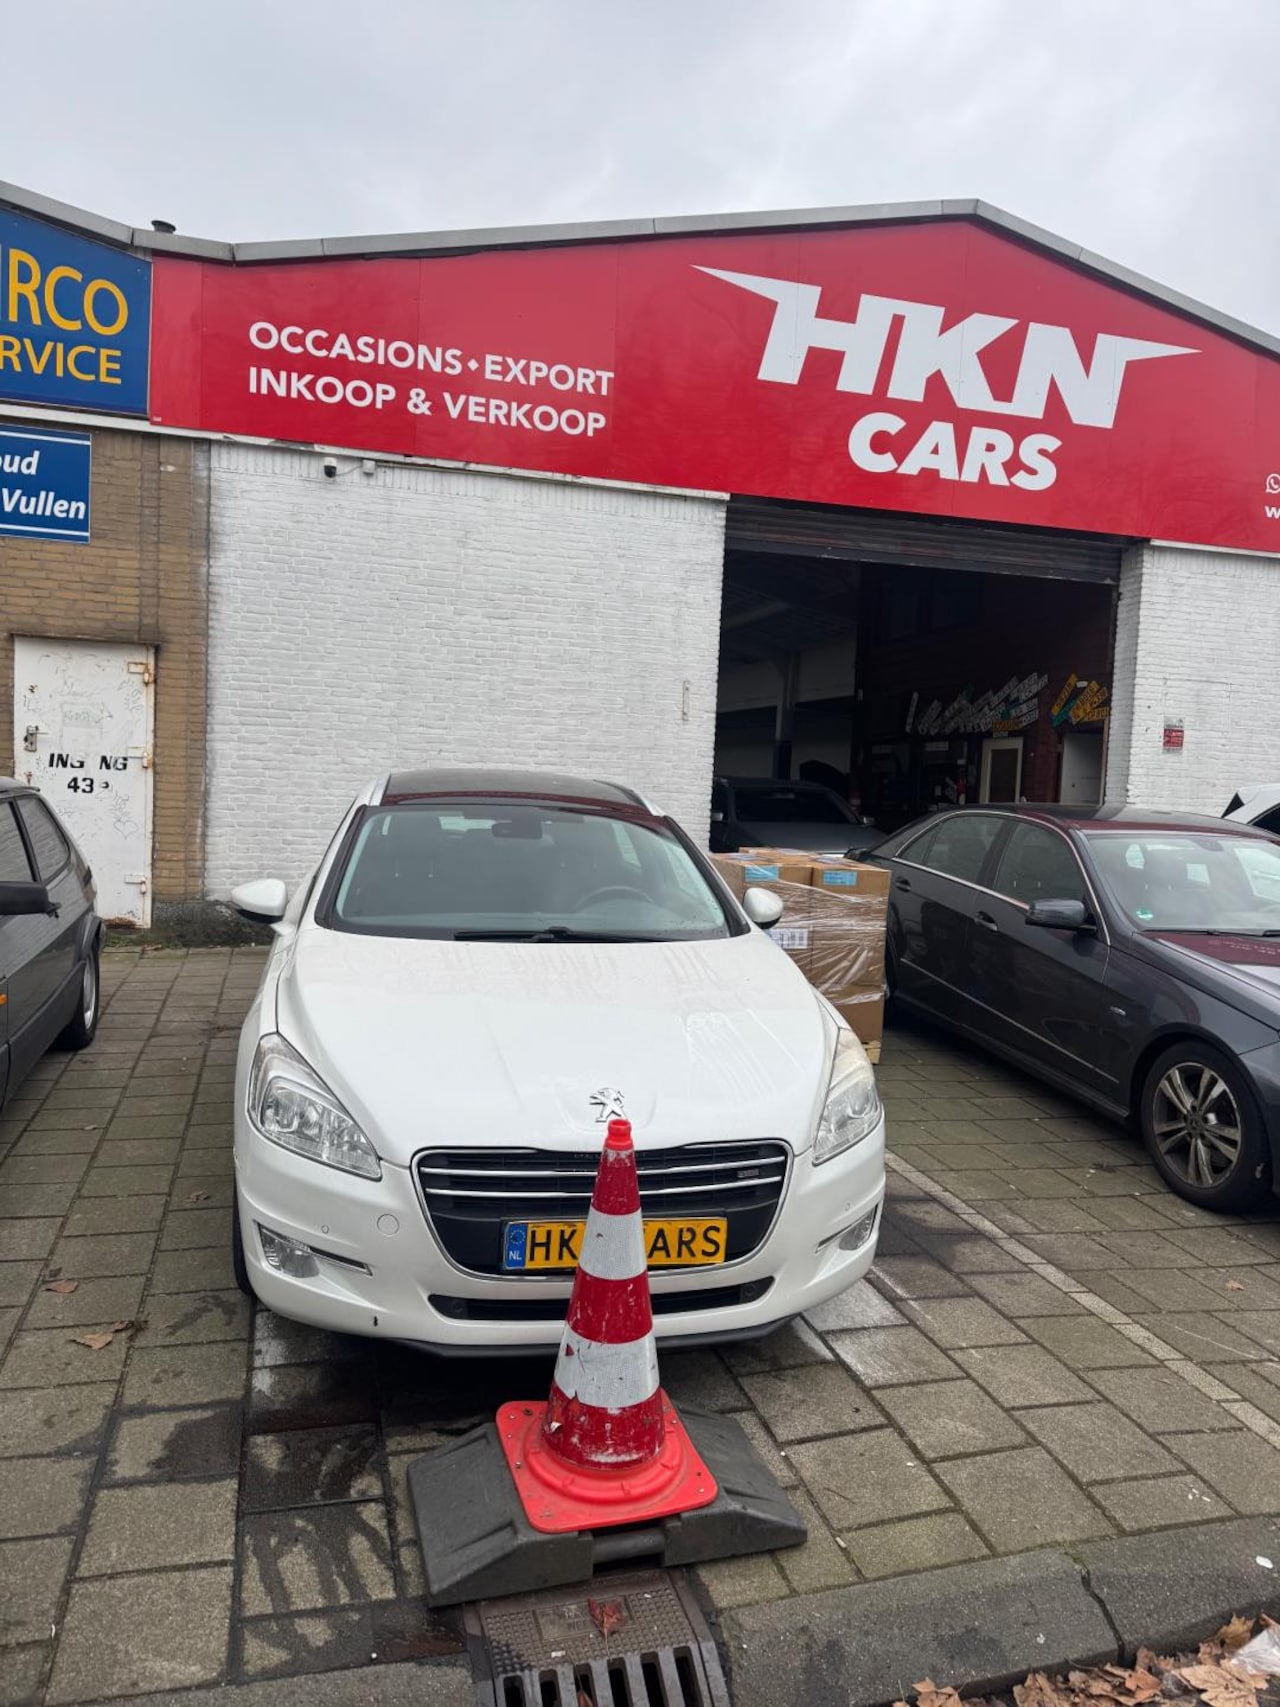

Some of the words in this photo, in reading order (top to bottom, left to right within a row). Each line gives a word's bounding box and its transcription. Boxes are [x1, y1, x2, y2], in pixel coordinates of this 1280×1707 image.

[0, 247, 129, 336] RCO
[249, 321, 463, 376] OCCASIONS
[484, 354, 615, 396] EXPORT
[691, 265, 1203, 428] HKN
[249, 366, 396, 409] INKOOP
[407, 387, 433, 416] &
[442, 392, 607, 437] VERKOOP
[0, 450, 40, 475] ud
[848, 411, 1063, 491] CARS
[2, 488, 87, 519] Vullen
[508, 1250, 522, 1261] NL
[529, 1229, 579, 1262] HK
[643, 1225, 721, 1259] ARS
